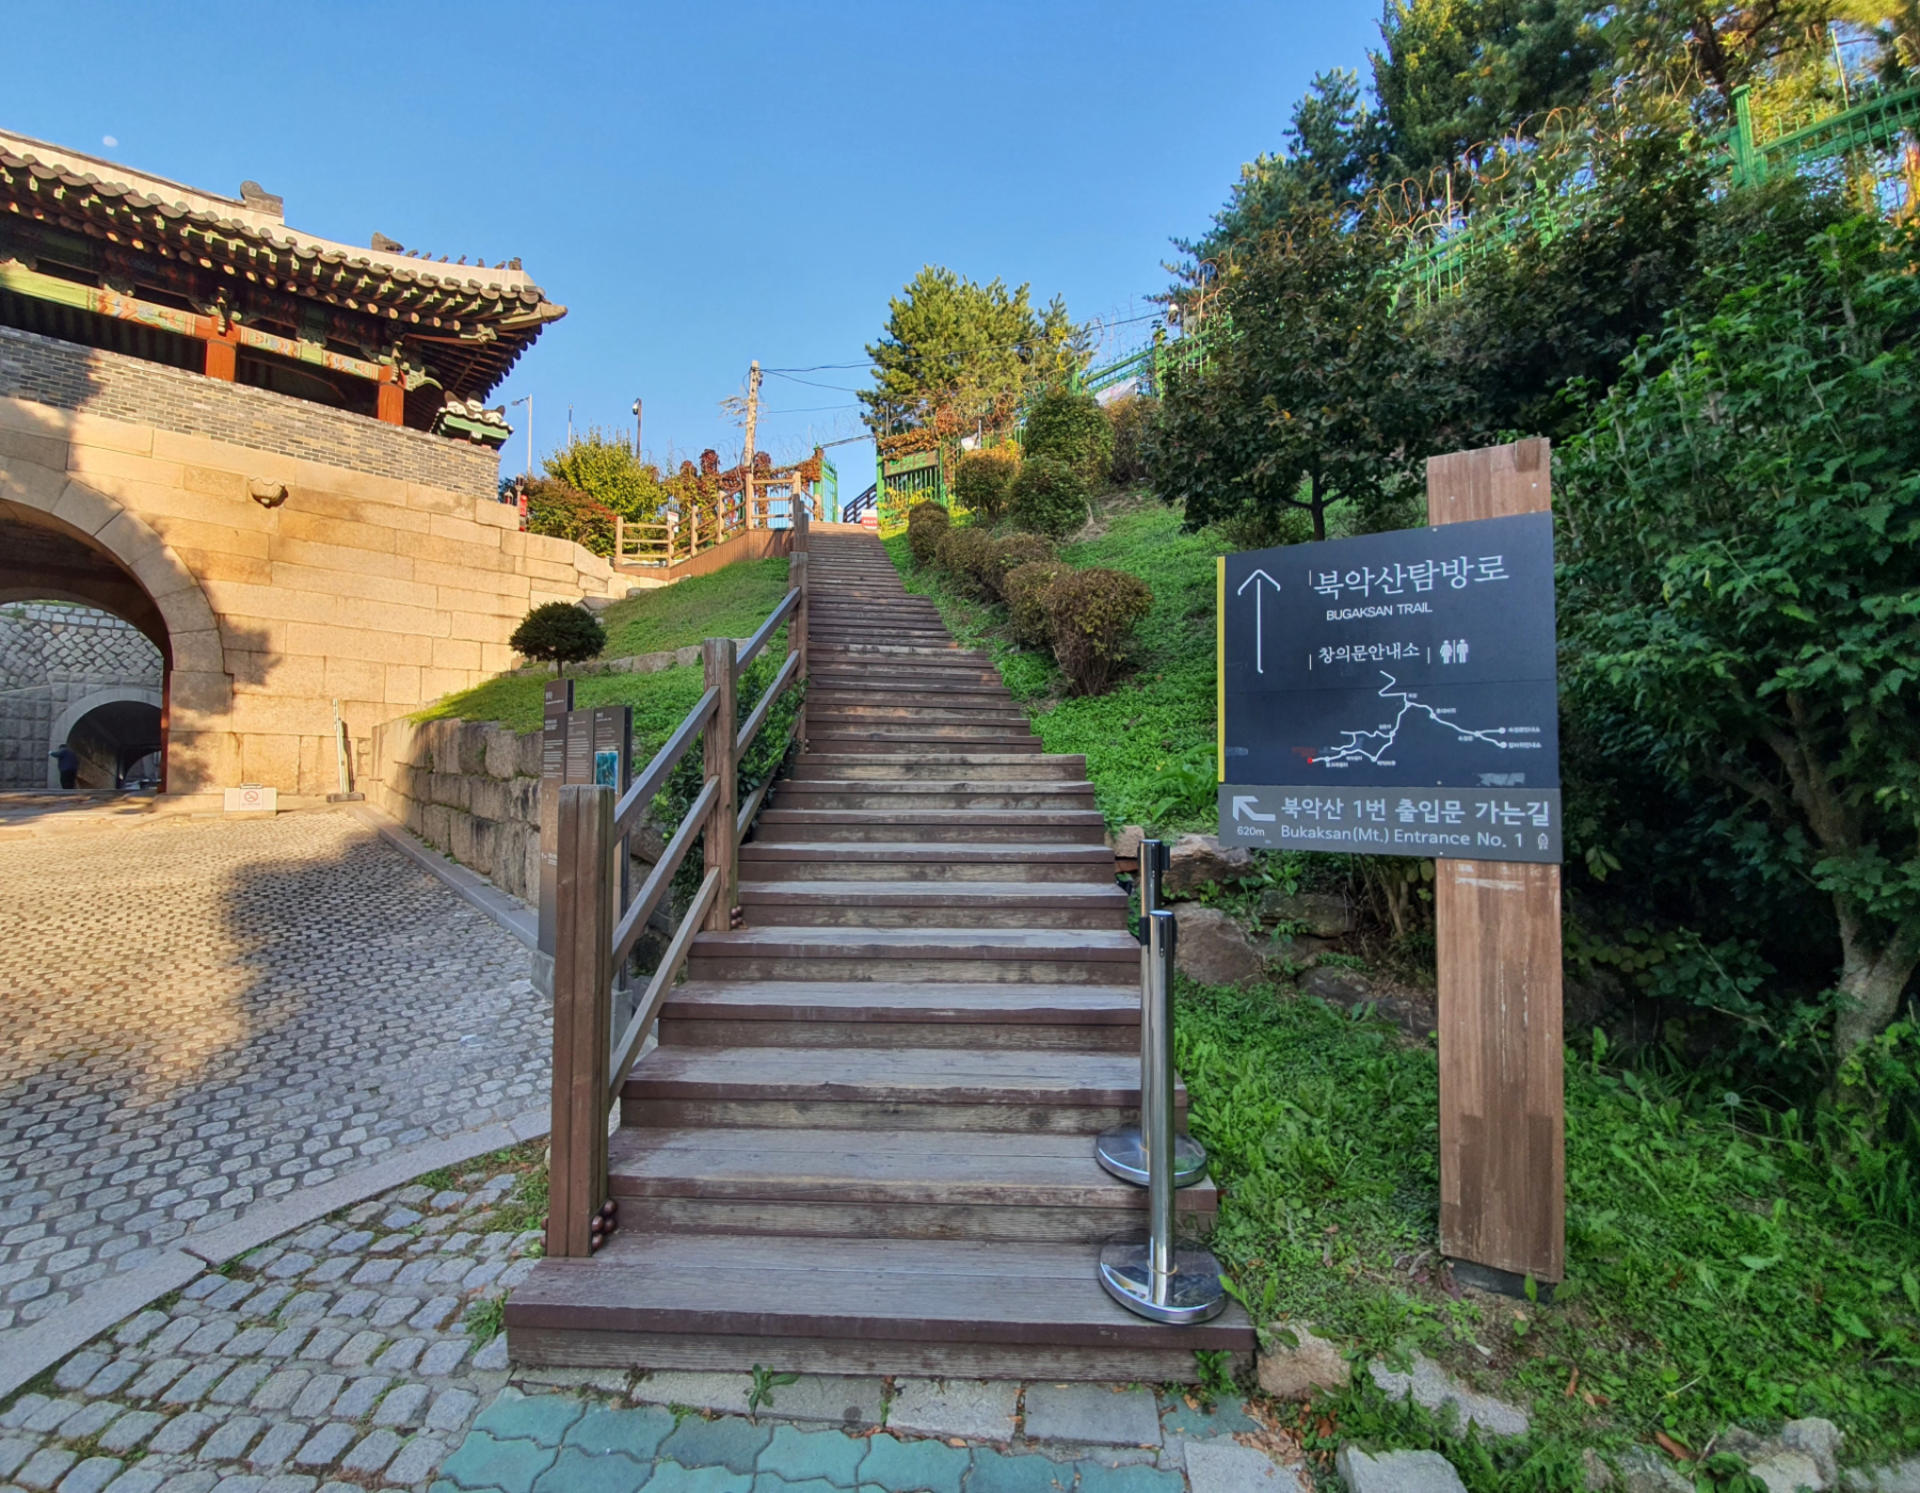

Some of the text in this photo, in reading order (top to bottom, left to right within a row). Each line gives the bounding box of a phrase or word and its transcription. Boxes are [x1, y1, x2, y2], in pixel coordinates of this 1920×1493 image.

[1313, 555, 1510, 600] 북악산탐방로
[1326, 602, 1433, 621] BUGAKSAN TRAIL
[1318, 641, 1420, 664] 창의문안내소
[1281, 797, 1550, 827] 북악산 1번 출입문 가는길
[1236, 825, 1265, 837] 620m
[1281, 825, 1523, 848] Bukaksan(Mt.) Entrance No. 1
